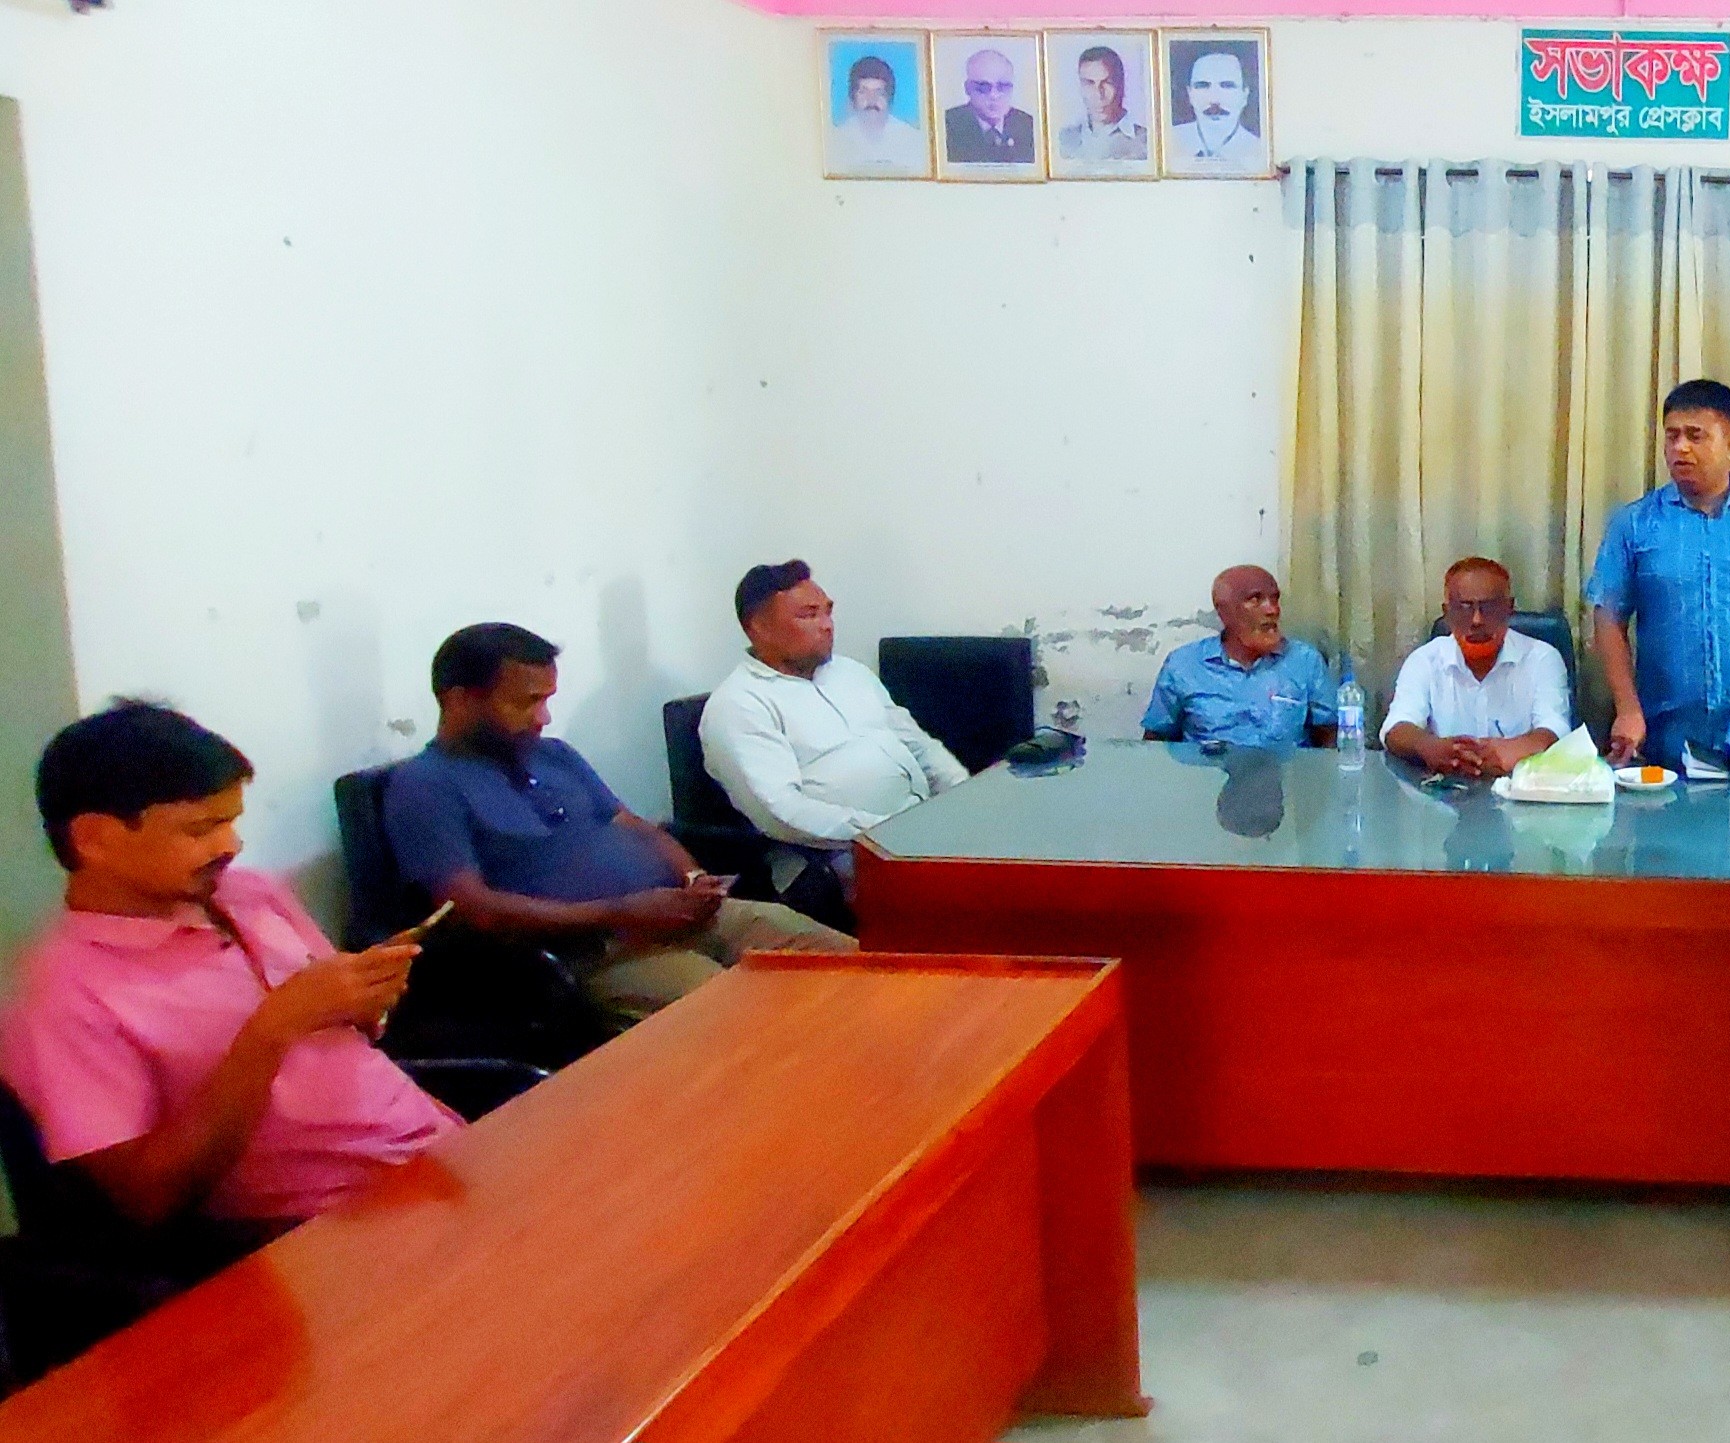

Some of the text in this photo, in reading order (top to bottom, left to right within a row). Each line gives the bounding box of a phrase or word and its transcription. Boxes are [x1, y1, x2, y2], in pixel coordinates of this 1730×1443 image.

[1523, 32, 1730, 103] সভাকক্ষ
[1527, 97, 1724, 136] ইসলামপুর প্রেসক্লাব
